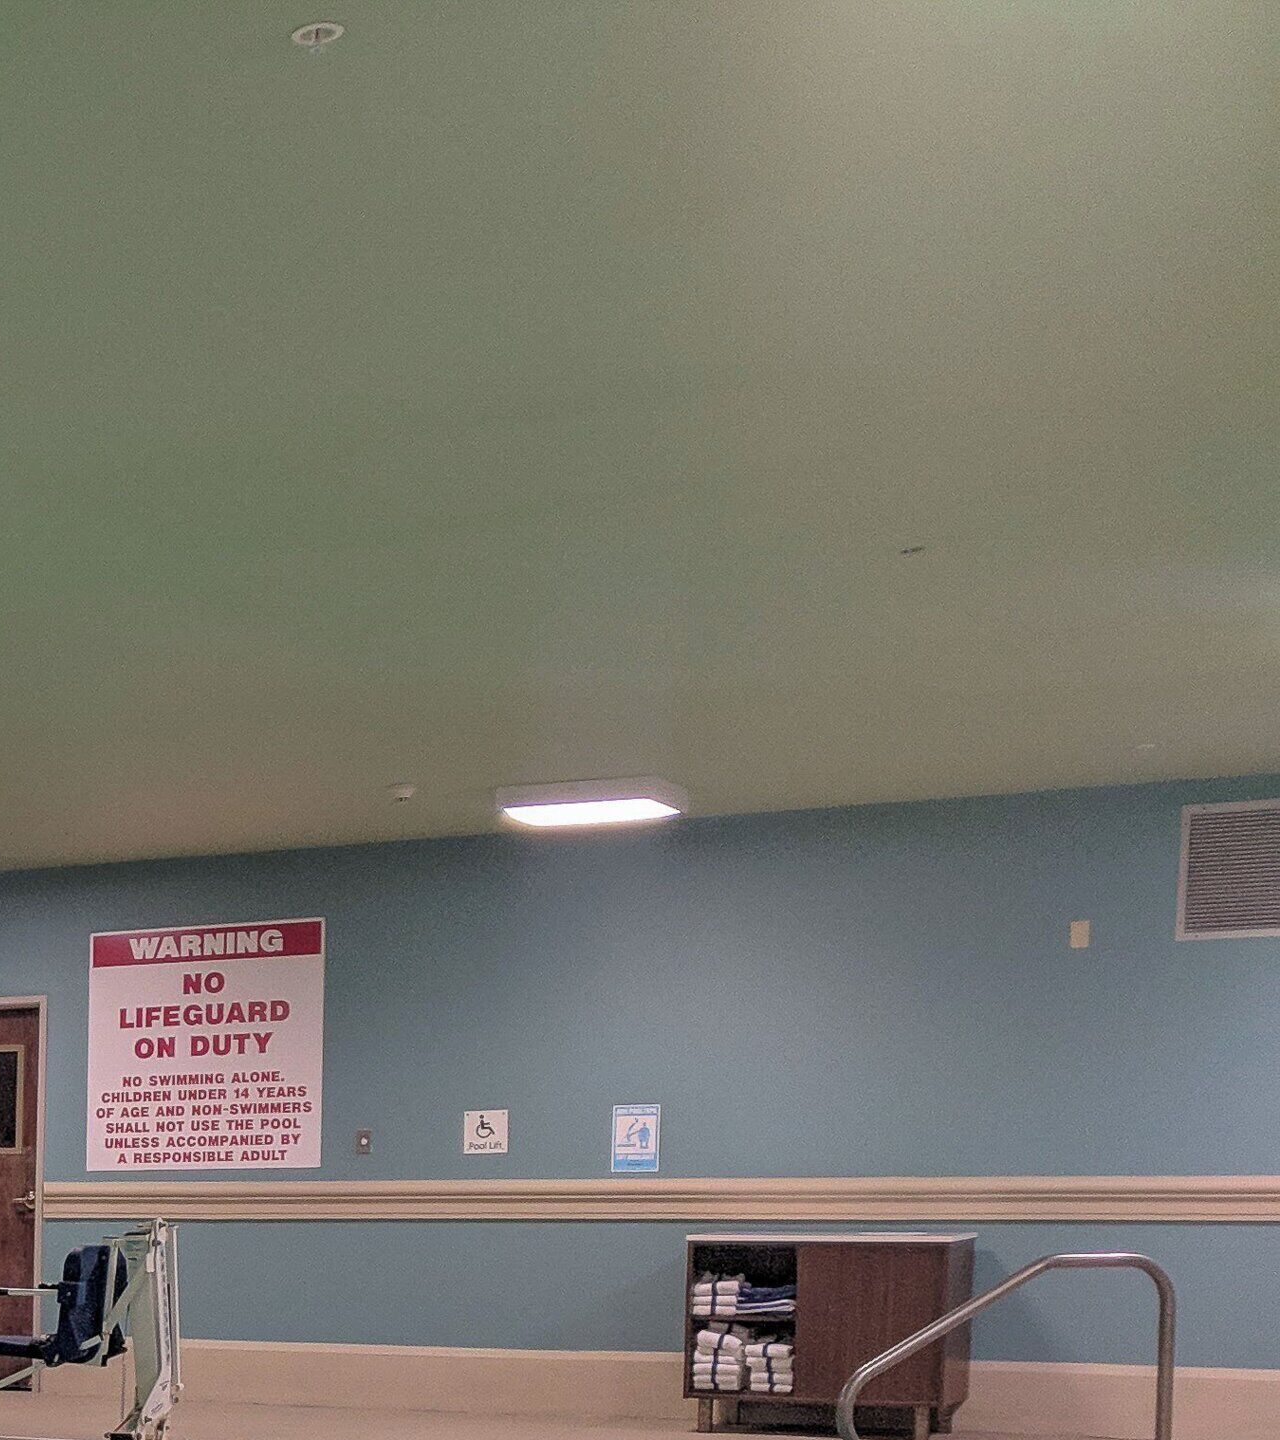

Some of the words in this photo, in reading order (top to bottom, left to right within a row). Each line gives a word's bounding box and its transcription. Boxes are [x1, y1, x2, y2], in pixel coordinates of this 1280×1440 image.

[129, 929, 283, 960] WARNING
[183, 972, 225, 995] NO
[119, 1000, 290, 1029] LIFEGUARD
[134, 1036, 175, 1059] ON
[191, 1032, 273, 1057] DUTY
[122, 1076, 142, 1088] NO
[149, 1073, 225, 1087] SWIMMING
[231, 1071, 285, 1084] ALONE.
[101, 1090, 172, 1103] CHILDREN
[178, 1088, 227, 1101] UNDER
[233, 1087, 249, 1099] 14
[256, 1086, 307, 1098] YEARS
[96, 1107, 115, 1119] OF
[120, 1107, 149, 1118] AGE
[155, 1106, 185, 1117] AND
[191, 1101, 312, 1116] NON-SWIMMERS
[106, 1122, 150, 1134] SHALL
[156, 1121, 184, 1133] NOT
[190, 1119, 220, 1131] USE
[226, 1119, 254, 1130] THE
[260, 1118, 301, 1130] POOL
[105, 1137, 159, 1149] UNLESS
[166, 1134, 274, 1148] ACCOMPANIED
[281, 1133, 301, 1145] BY
[469, 1142, 487, 1150] Pool
[117, 1153, 127, 1164] A
[133, 1151, 233, 1164] RESPONSIBLE
[240, 1150, 287, 1161] ADULT
